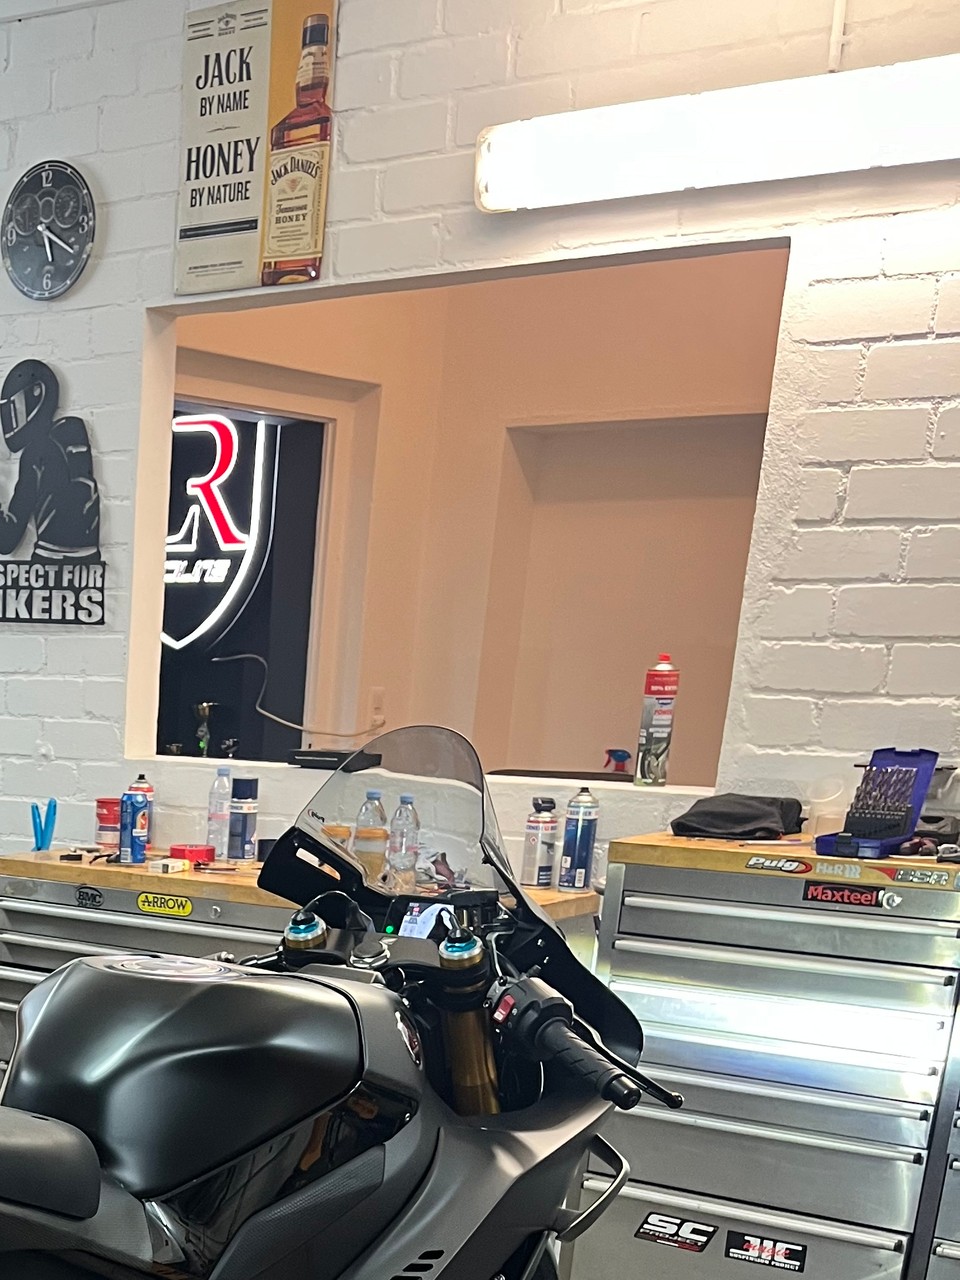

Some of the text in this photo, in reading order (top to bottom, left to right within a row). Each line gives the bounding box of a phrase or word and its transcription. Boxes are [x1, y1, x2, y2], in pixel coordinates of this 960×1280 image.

[196, 46, 253, 90] JACK
[200, 89, 249, 117] BY NAME
[186, 136, 260, 182] HONEY
[271, 156, 321, 185] JACK DANIEL'S
[190, 180, 251, 208] BY NATURE
[275, 213, 308, 224] HONEY
[62, 563, 103, 588] FOR
[748, 856, 800, 871] Puig
[78, 890, 101, 904] BMC
[141, 895, 188, 911] ARROW
[808, 885, 877, 905] Maxteel
[639, 1228, 706, 1246] PROJECT
[642, 1213, 715, 1242] SC
